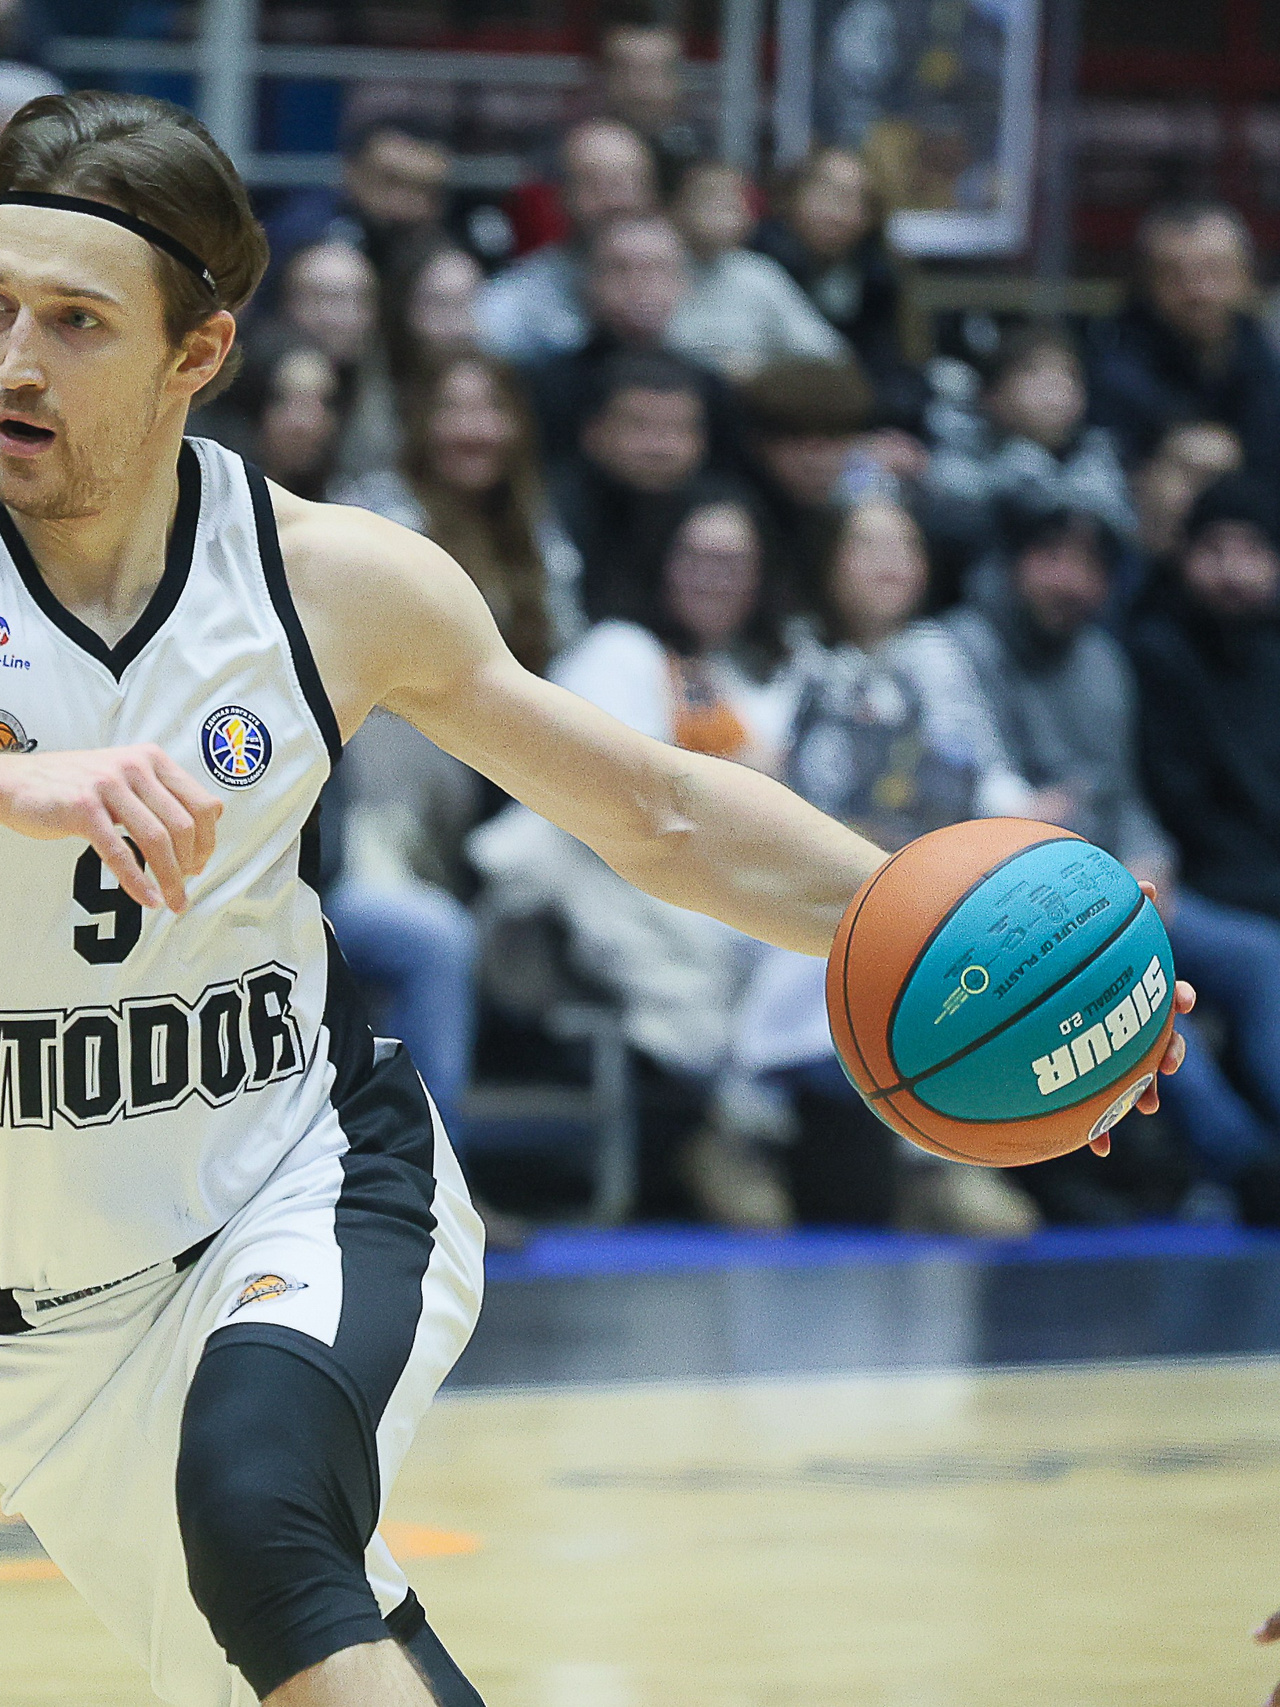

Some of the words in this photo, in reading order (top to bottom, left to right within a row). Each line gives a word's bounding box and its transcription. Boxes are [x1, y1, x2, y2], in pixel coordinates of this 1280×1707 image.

[72, 834, 146, 966] 9
[1077, 896, 1111, 926] SECOND
[1054, 920, 1079, 945] LIFE
[1040, 941, 1055, 958] OF
[995, 955, 1039, 1001] PLASTIC
[1031, 954, 1168, 1096] SIBUR
[1058, 1011, 1084, 1036] 2.0
